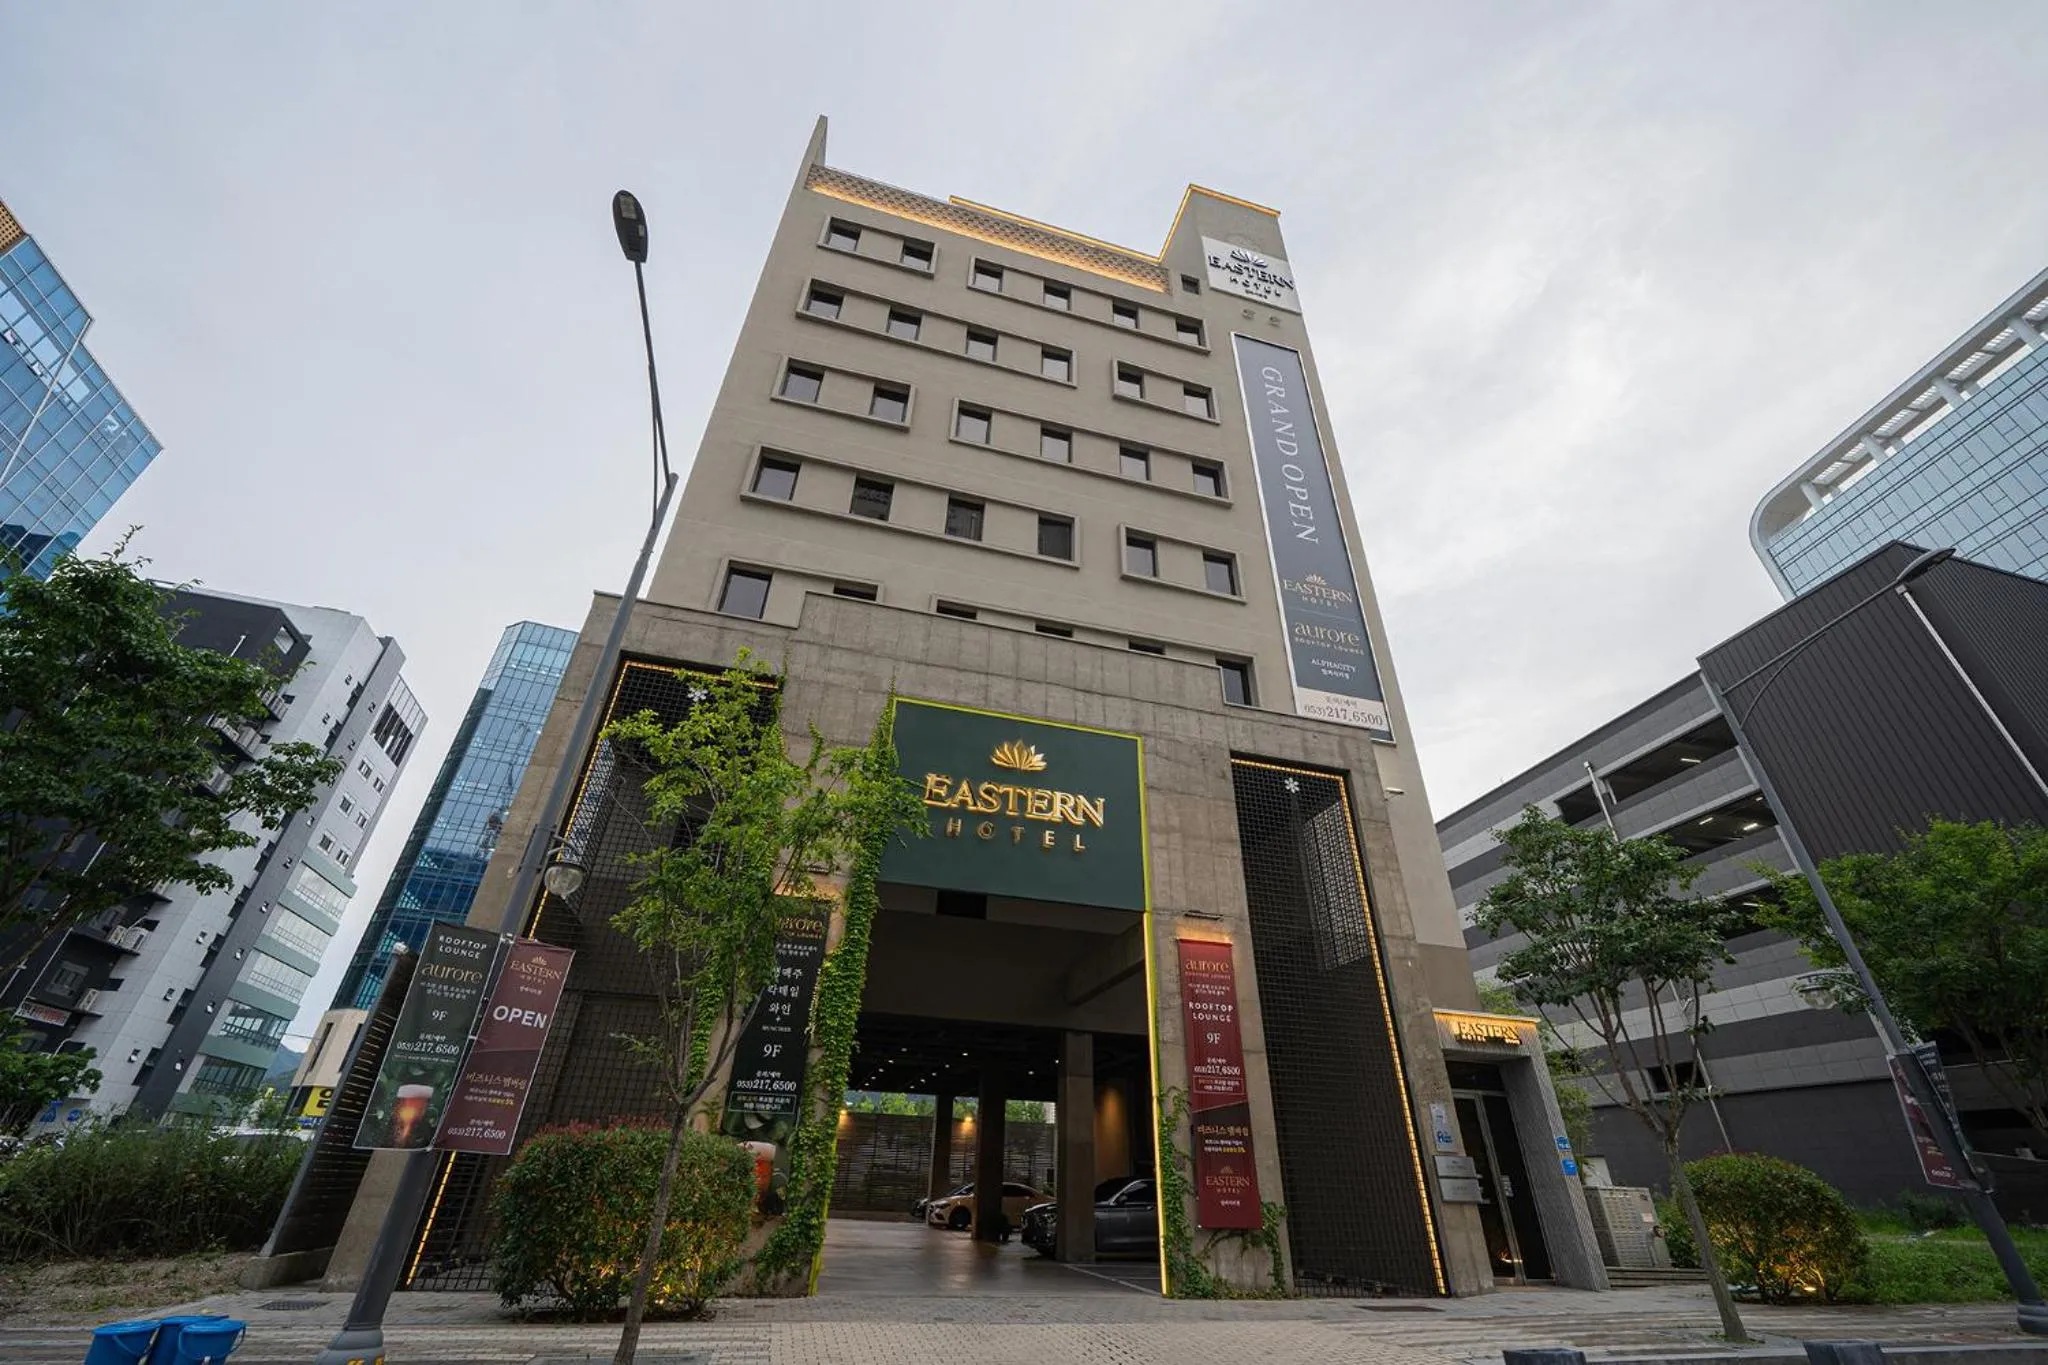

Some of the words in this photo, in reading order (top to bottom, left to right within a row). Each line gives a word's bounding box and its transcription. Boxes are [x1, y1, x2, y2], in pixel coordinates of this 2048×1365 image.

[1208, 255, 1294, 290] EASTERN
[1261, 366, 1299, 457] GRAND
[1281, 463, 1319, 545] OPEN
[1283, 579, 1353, 603] EASTERN
[1295, 622, 1360, 646] aurore
[924, 772, 1105, 828] EASTERN
[946, 817, 1086, 852] HOTEL
[439, 935, 487, 950] ROOFTOP
[439, 945, 481, 959] LOUNGE
[421, 962, 483, 984] aurore
[510, 960, 562, 980] EASTERN
[1185, 959, 1229, 973] aurore
[432, 1008, 448, 1020] 9F
[769, 1002, 791, 1015] 와인
[1188, 1001, 1233, 1012] ROOFTOP
[492, 1005, 548, 1029] OPEN
[1192, 1012, 1232, 1022] LOUNGE
[1206, 1032, 1221, 1044] 9F
[1456, 1021, 1521, 1041] EASTERN
[763, 1043, 783, 1058] 9F
[1206, 1175, 1250, 1187] EASTERN
